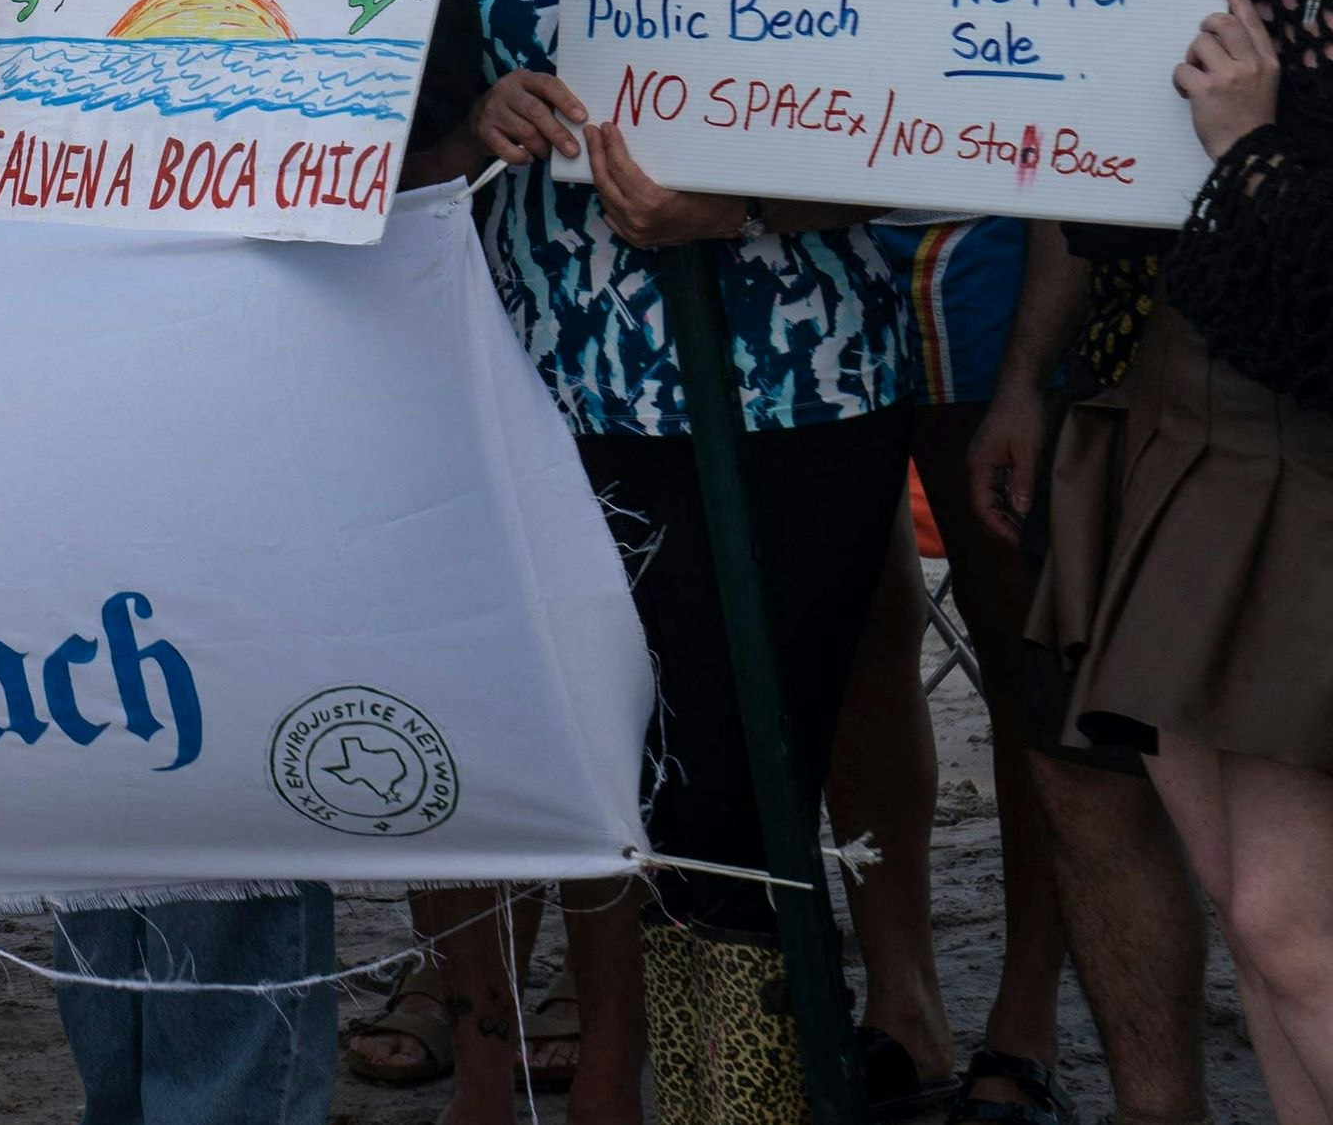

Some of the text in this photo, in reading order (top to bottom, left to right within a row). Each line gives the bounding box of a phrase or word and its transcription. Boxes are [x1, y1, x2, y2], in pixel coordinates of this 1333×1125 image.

[149, 137, 258, 211] BOCA
[275, 139, 392, 215] CHICA
[612, 64, 687, 127] NO
[1050, 127, 1137, 184] Base
[281, 699, 451, 822] STX ENVIROJUSTICE NETWORK
